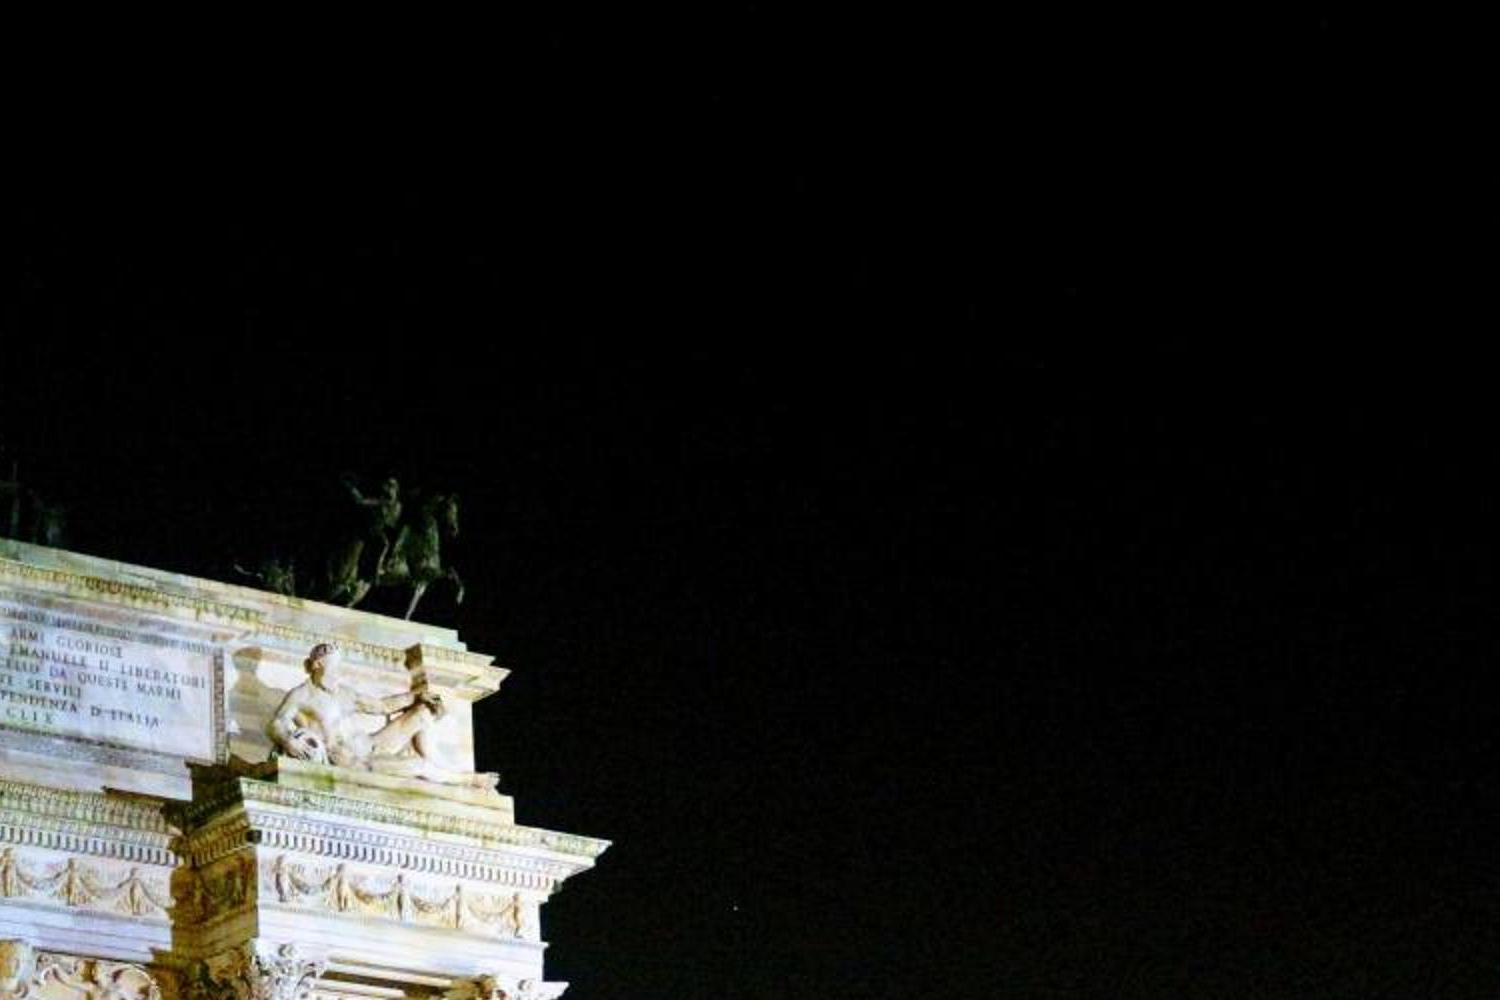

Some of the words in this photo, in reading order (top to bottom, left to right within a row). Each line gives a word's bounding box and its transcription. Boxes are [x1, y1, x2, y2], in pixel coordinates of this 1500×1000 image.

[11, 627, 45, 641] ARMI
[56, 635, 123, 658] GLORIOSE
[10, 643, 86, 667] EMANUELE
[121, 663, 205, 688] LIBERATORI
[50, 665, 67, 679] DA
[137, 682, 181, 699] MARMI
